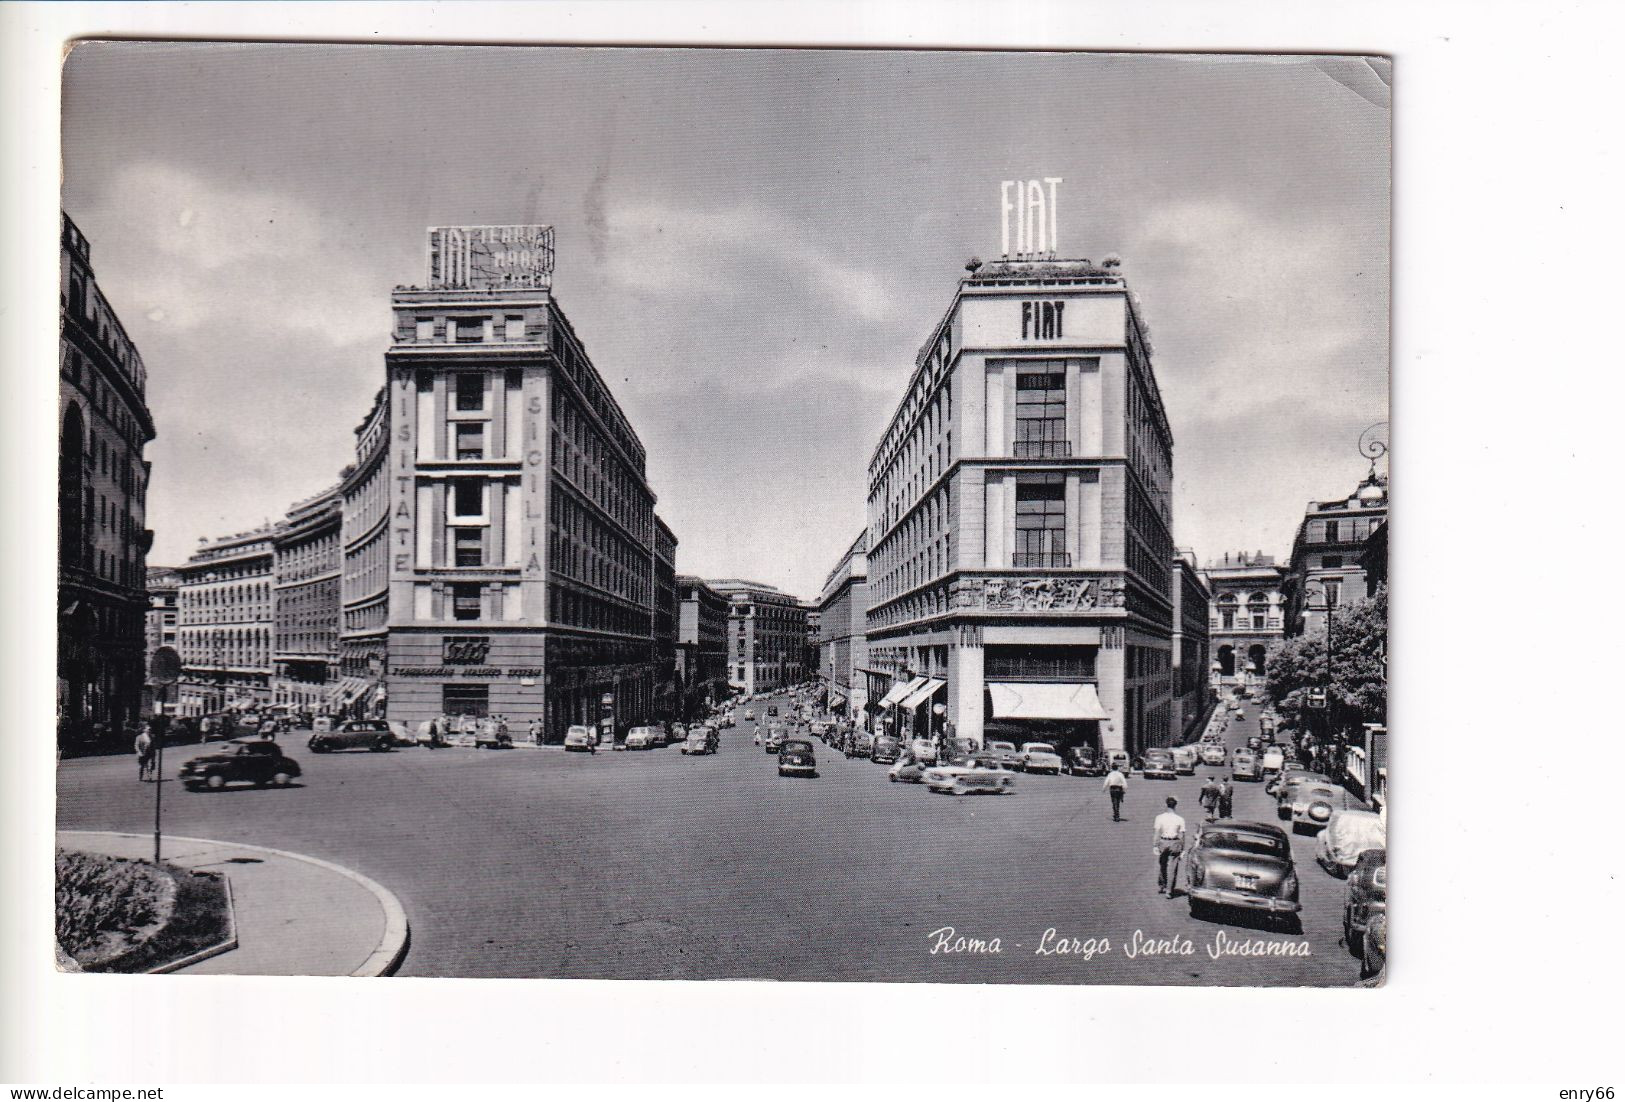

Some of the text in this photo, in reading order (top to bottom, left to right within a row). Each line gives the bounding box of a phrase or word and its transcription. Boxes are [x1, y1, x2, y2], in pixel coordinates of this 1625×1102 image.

[1001, 177, 1063, 255] FIAT
[427, 227, 472, 288] FIAT
[1022, 301, 1064, 340] FIAT
[395, 369, 411, 572] VISITATE
[526, 397, 541, 572] SICILIA
